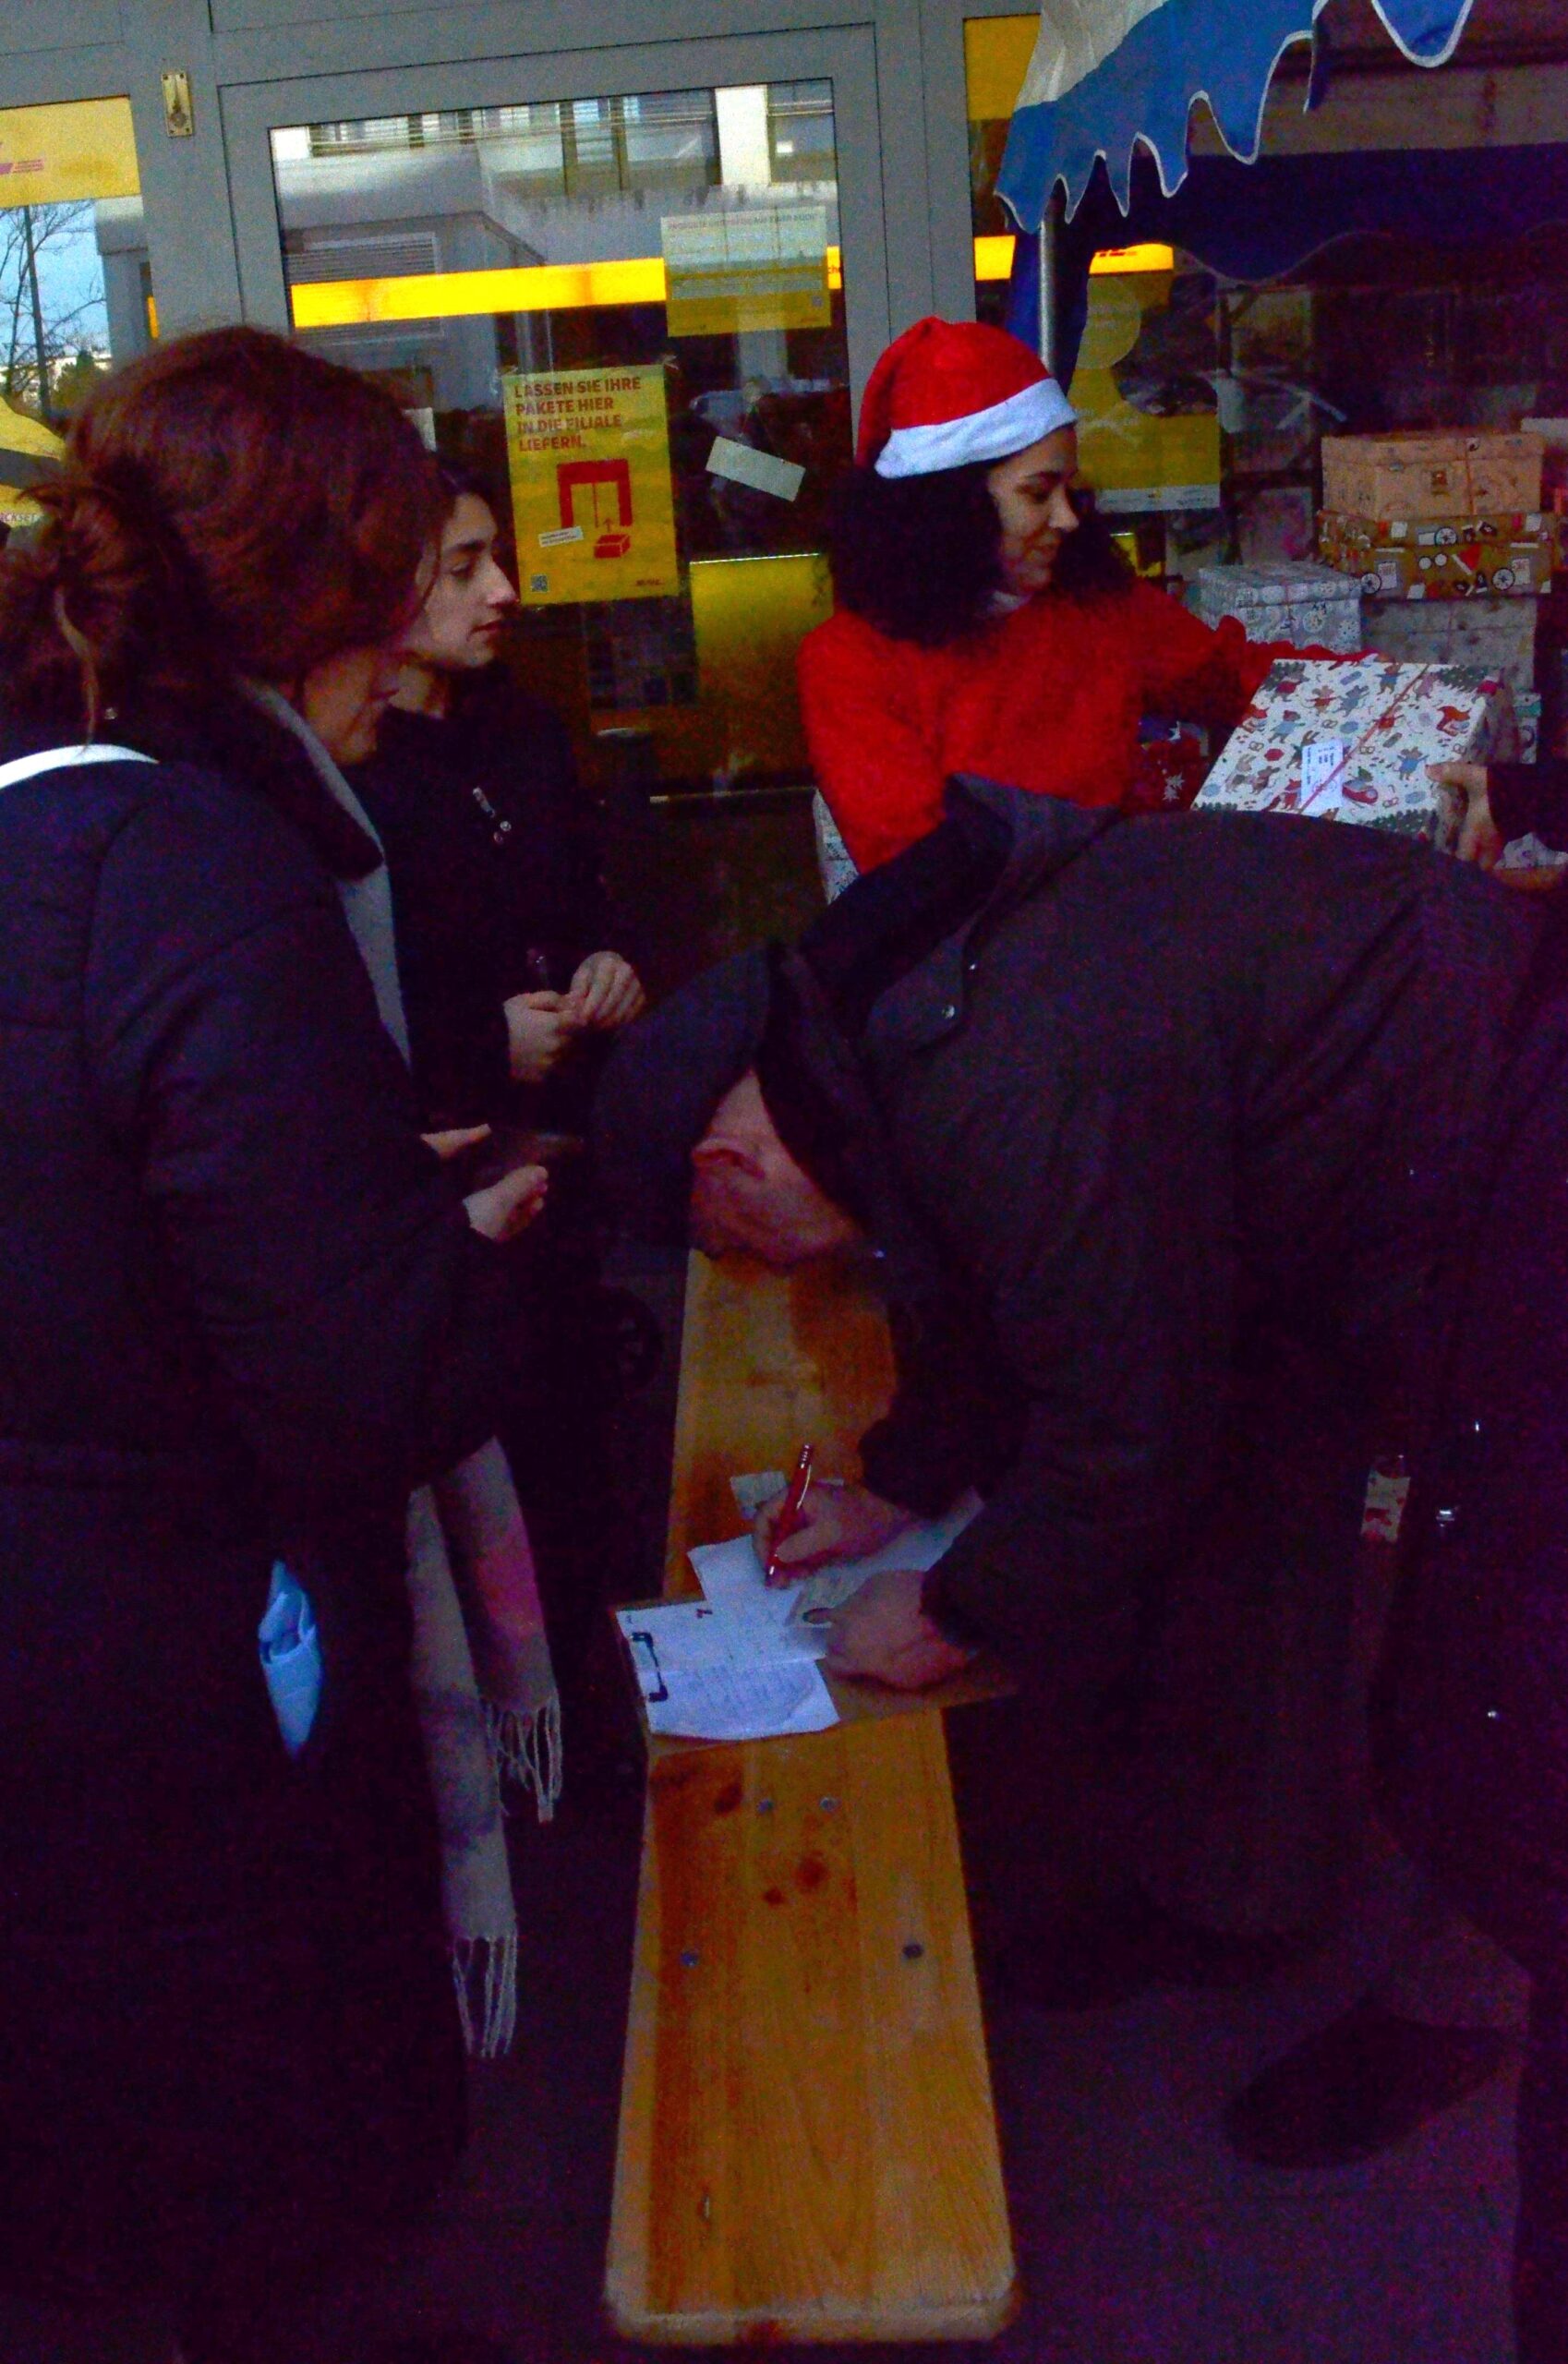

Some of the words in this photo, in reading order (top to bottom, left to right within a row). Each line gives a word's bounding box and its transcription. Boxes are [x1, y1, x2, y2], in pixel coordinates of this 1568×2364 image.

[514, 381, 573, 398] LASSEN
[577, 379, 601, 393] SIE
[605, 377, 641, 392] IHRE
[515, 400, 574, 416] PAKETE
[578, 396, 613, 411] HIER
[517, 421, 535, 434] IN
[537, 417, 562, 433] DIE
[565, 413, 621, 430] FILIALE
[519, 435, 586, 452] LIEFERN.
